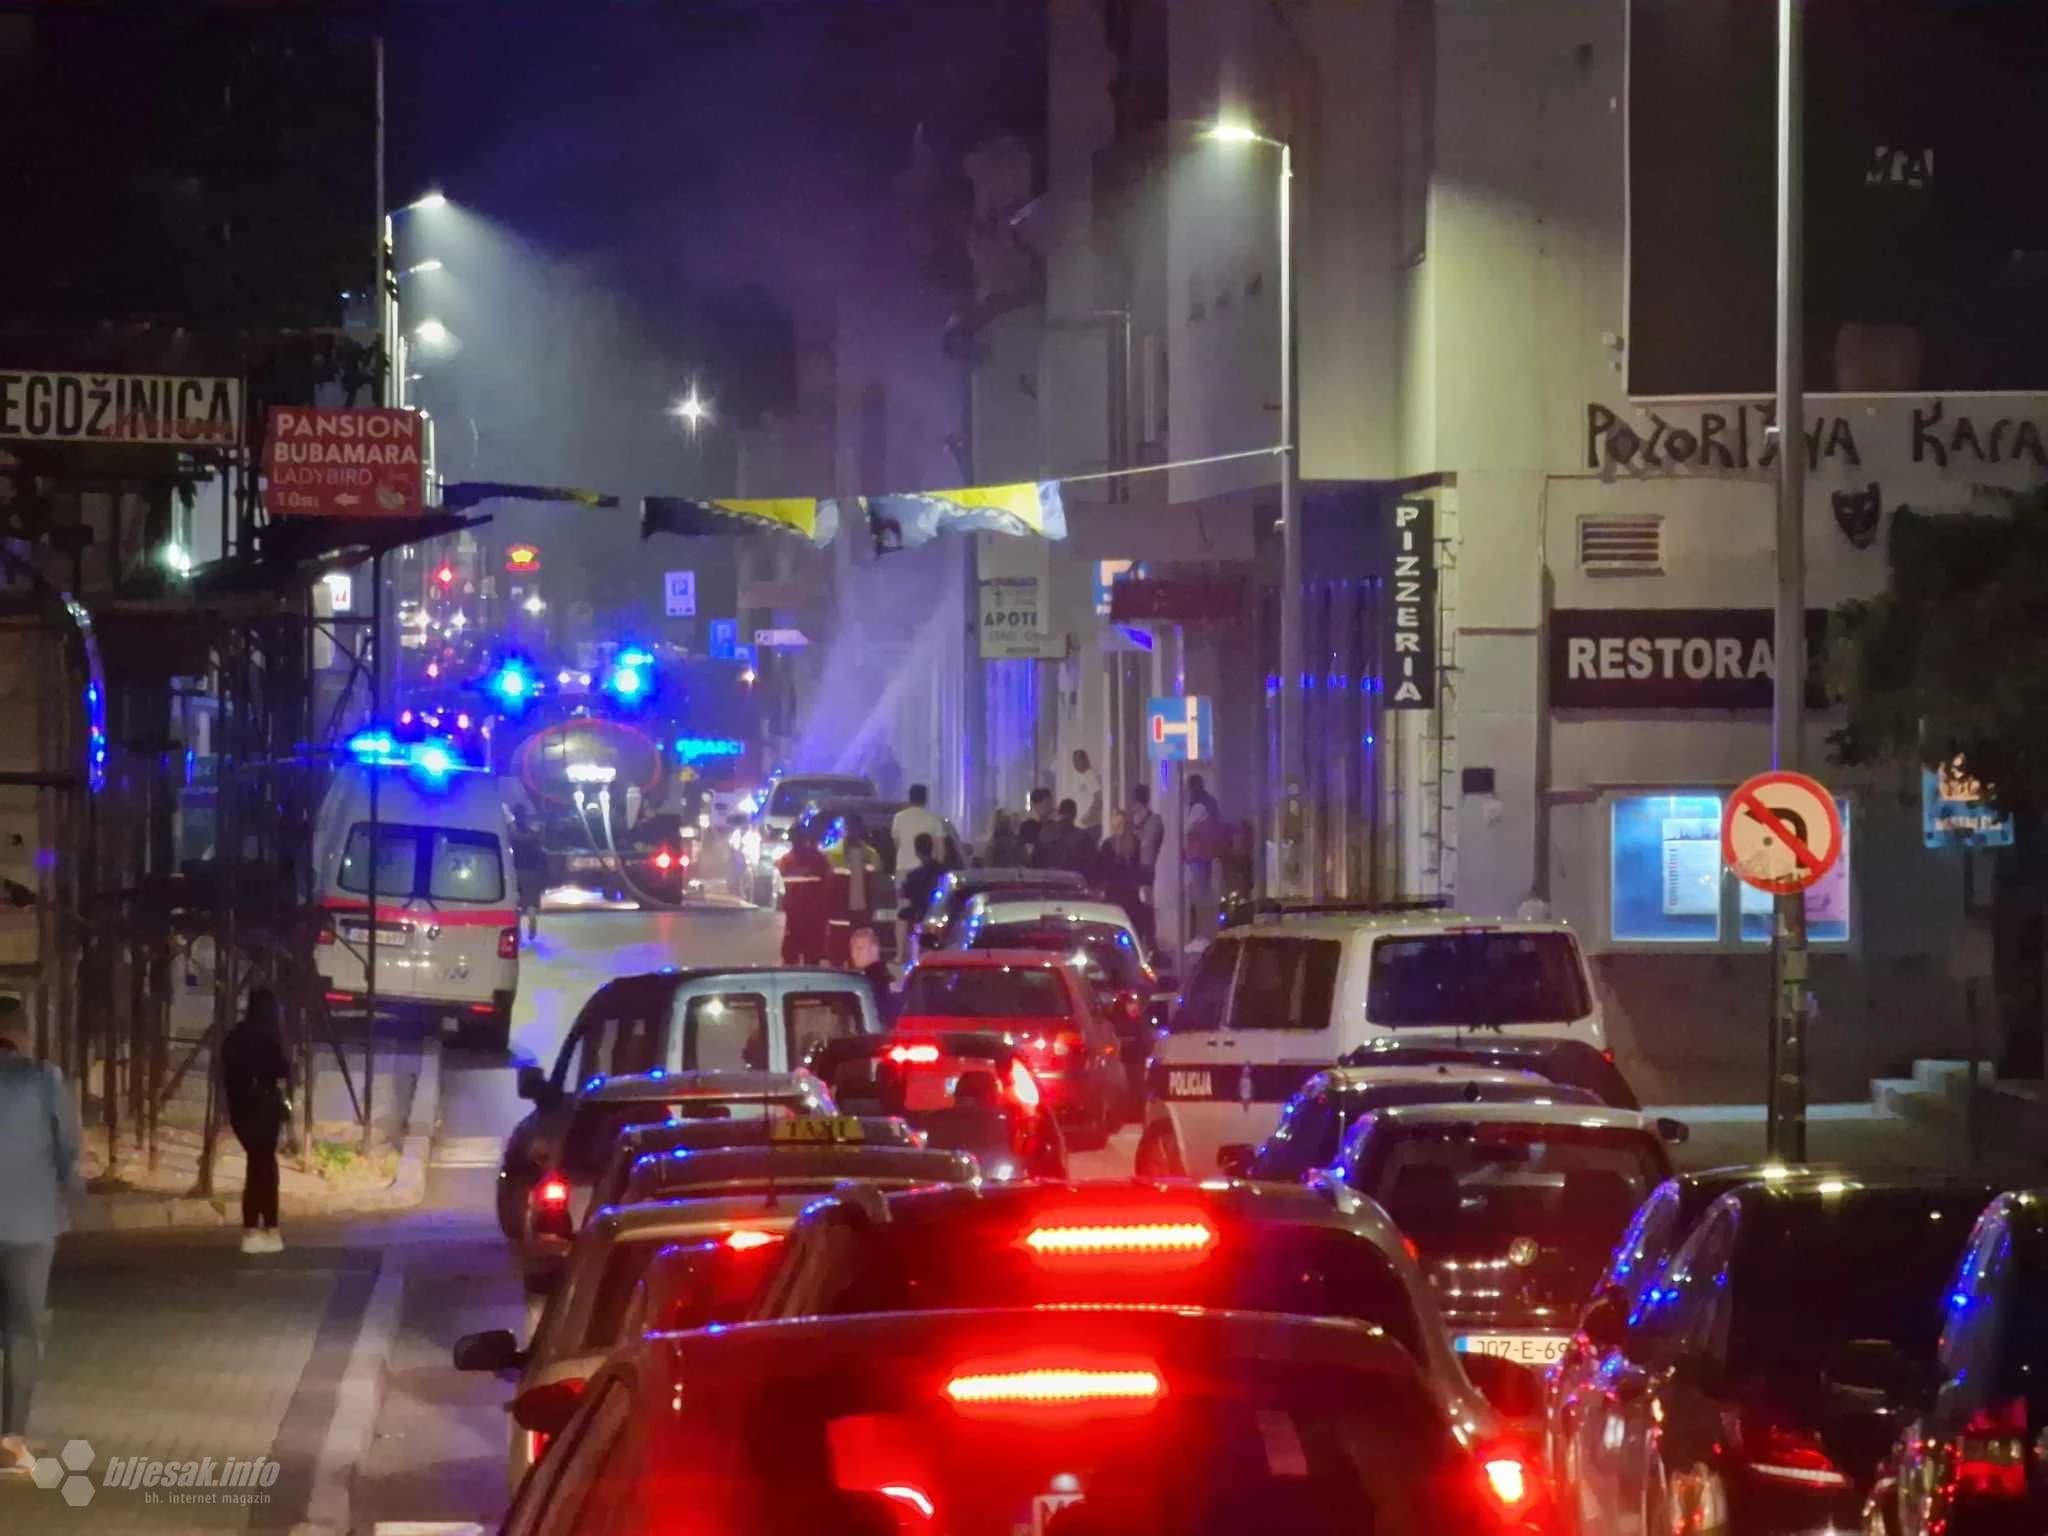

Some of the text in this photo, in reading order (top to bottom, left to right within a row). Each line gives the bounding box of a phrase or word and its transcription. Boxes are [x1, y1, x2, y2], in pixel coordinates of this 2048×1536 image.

[0, 374, 234, 440] EGDŽINICA
[277, 413, 413, 439] PANSION
[274, 442, 418, 464] BUBAMARA
[273, 467, 373, 486] LADYBIRD
[1394, 506, 1422, 701] PIZZERIA
[1567, 636, 1808, 680] RESTORA
